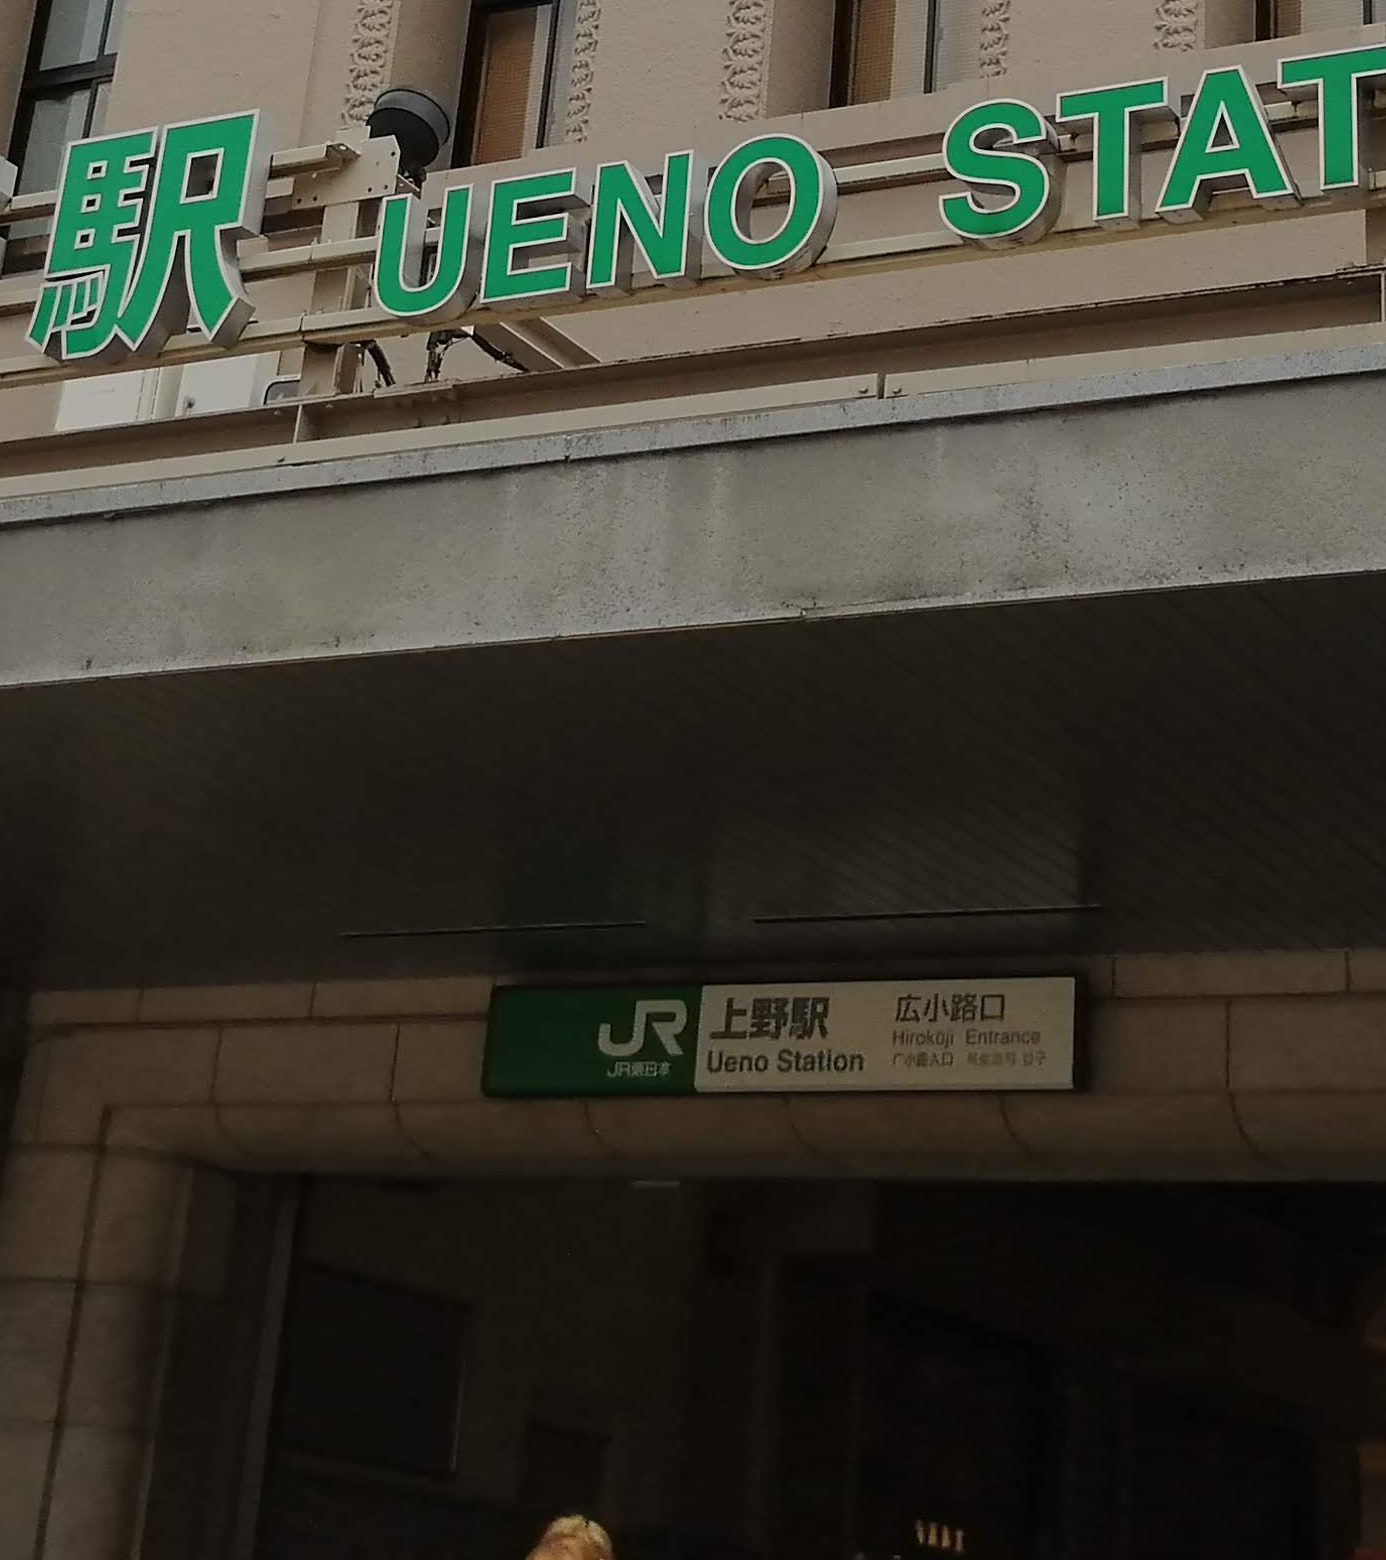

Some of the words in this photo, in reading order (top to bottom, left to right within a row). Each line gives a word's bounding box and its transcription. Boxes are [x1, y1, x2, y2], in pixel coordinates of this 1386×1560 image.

[369, 132, 824, 318] UENO
[709, 997, 830, 1040] 上野駅
[896, 993, 1005, 1022] 広小路口
[598, 999, 688, 1056] JR
[893, 1030, 954, 1049] Hirokoji
[965, 1028, 1042, 1045] Entrance
[707, 1050, 769, 1073] Ueno
[776, 1048, 864, 1073] Station
